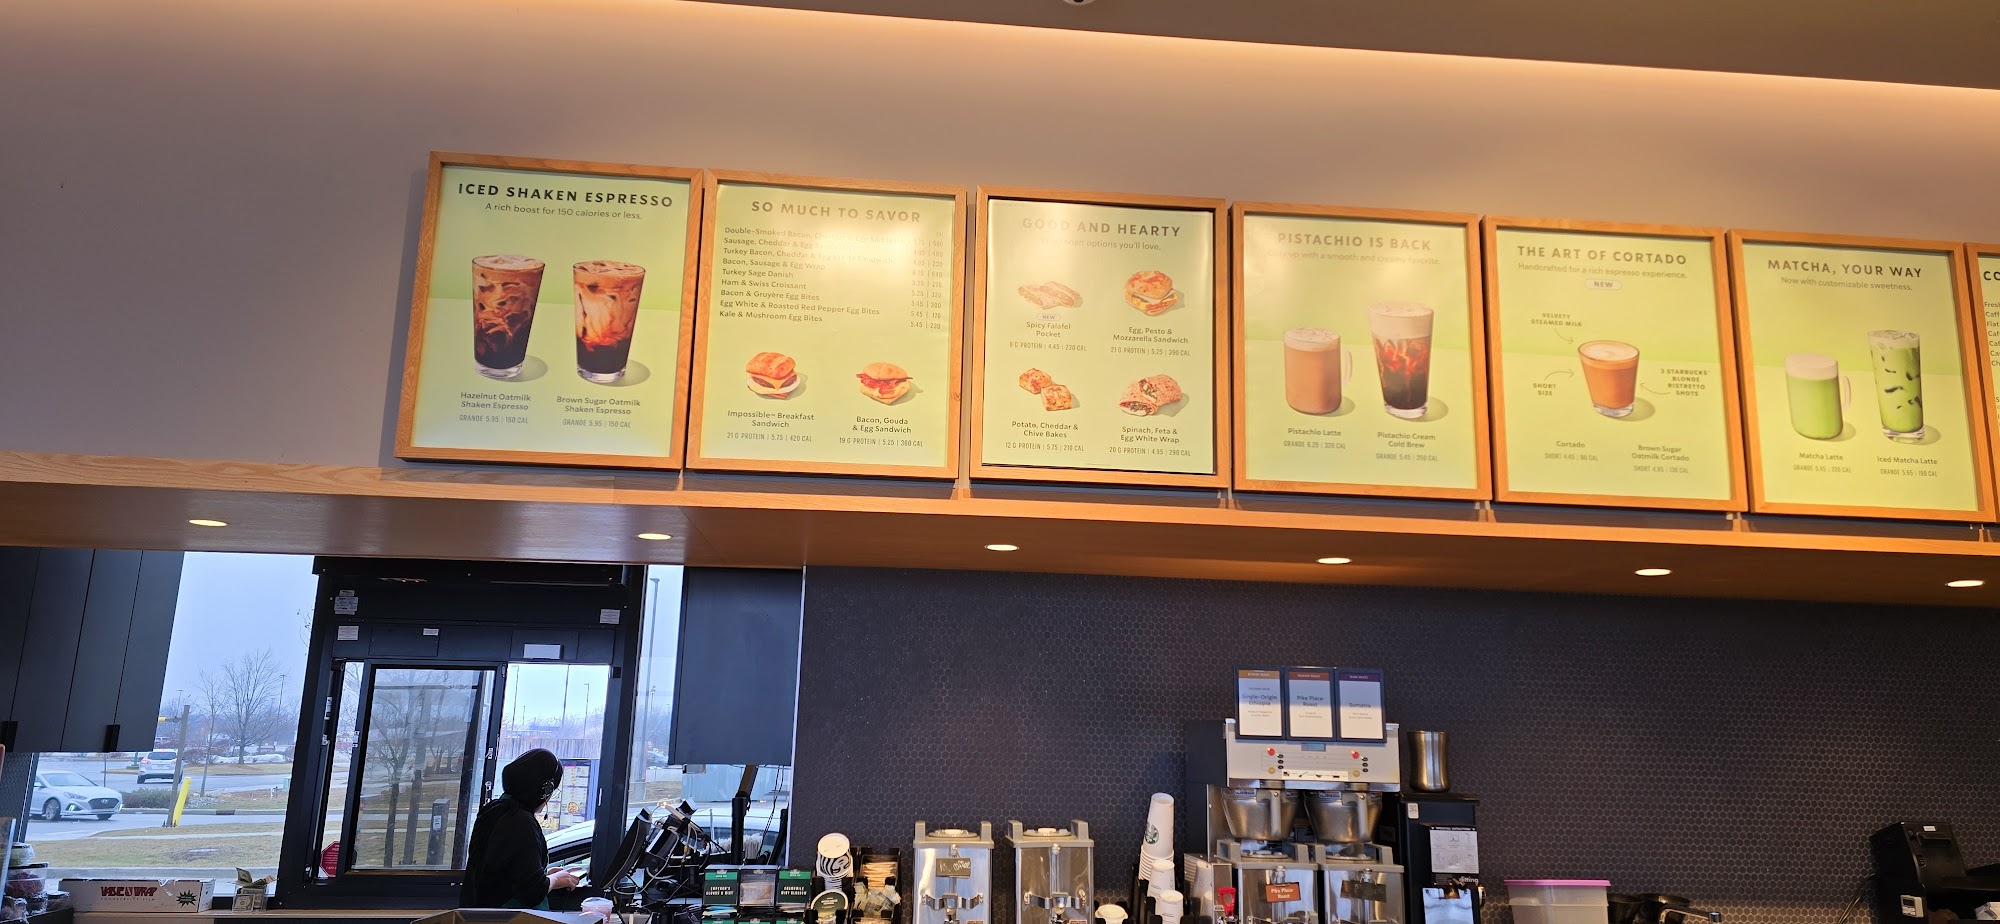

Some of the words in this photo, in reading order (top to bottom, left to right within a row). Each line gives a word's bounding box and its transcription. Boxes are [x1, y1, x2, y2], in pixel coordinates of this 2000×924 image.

[458, 183, 498, 195] ICED
[507, 187, 577, 201] SHAKEN
[586, 192, 672, 207] ESPRESSO
[494, 204, 511, 212] rich
[514, 205, 540, 214] boost
[542, 206, 554, 214] for
[558, 208, 573, 216] 150
[576, 209, 609, 218] calories
[624, 210, 641, 219] less.
[752, 201, 773, 212] SO
[781, 203, 830, 217] MUCH
[838, 208, 858, 219] TO
[866, 209, 921, 222] SAVOR
[1023, 218, 1070, 230] GOOD
[1077, 221, 1110, 233] AND
[1118, 224, 1180, 236] HEARTY
[724, 237, 756, 246] Sausage,
[759, 239, 790, 247] Cheddar
[1086, 240, 1117, 249] options
[1119, 242, 1140, 250] you'll
[1278, 233, 1362, 246] PISTACHIO
[1370, 237, 1383, 247] IS
[1390, 238, 1431, 250] BACK
[724, 248, 747, 256] Turkey
[777, 250, 808, 258] Cheddar
[1327, 253, 1358, 261] smooth
[1518, 246, 1545, 257] THE
[1552, 248, 1580, 259] ART
[1588, 250, 1606, 260] OF
[1613, 251, 1686, 265] CORTADO
[723, 258, 748, 266] Bacon,
[750, 259, 780, 268] Sausage
[805, 262, 825, 270] Wrap
[1768, 260, 1836, 275] MATCHA,
[1842, 264, 1883, 276] YOUR
[1889, 267, 1921, 278] WAY
[722, 269, 746, 277] Turkey
[1518, 263, 1567, 272] Handcrafted
[1605, 269, 1640, 277] espresso
[1642, 270, 1687, 278] experience.
[772, 281, 806, 289] Croissant
[1818, 279, 1868, 288] customizable
[1871, 282, 1912, 290] sweetness.
[754, 291, 783, 299] Gruyère
[720, 300, 733, 308] Egg
[769, 302, 799, 310] Roasted
[818, 305, 844, 313] Pepper
[847, 307, 860, 315] Egg
[746, 312, 786, 320] Mushroom
[789, 314, 802, 322] Egg
[1027, 322, 1045, 330] Spicy
[1113, 334, 1151, 342] Mozzarella
[461, 392, 497, 400] Hazelnut
[557, 396, 582, 404] Brown
[585, 398, 607, 406] Sugar
[461, 401, 490, 409] Shaken
[493, 403, 528, 411] Espresso
[596, 407, 631, 416] Espresso
[777, 412, 814, 420] Breakfast
[752, 420, 789, 428] Sandwich
[856, 416, 881, 424] Bacon,
[860, 425, 873, 433] Egg
[1012, 421, 1038, 429] Potato,
[1040, 422, 1071, 430] Cheddar
[1122, 426, 1153, 434] Spinach,
[1160, 436, 1179, 444] Wrap
